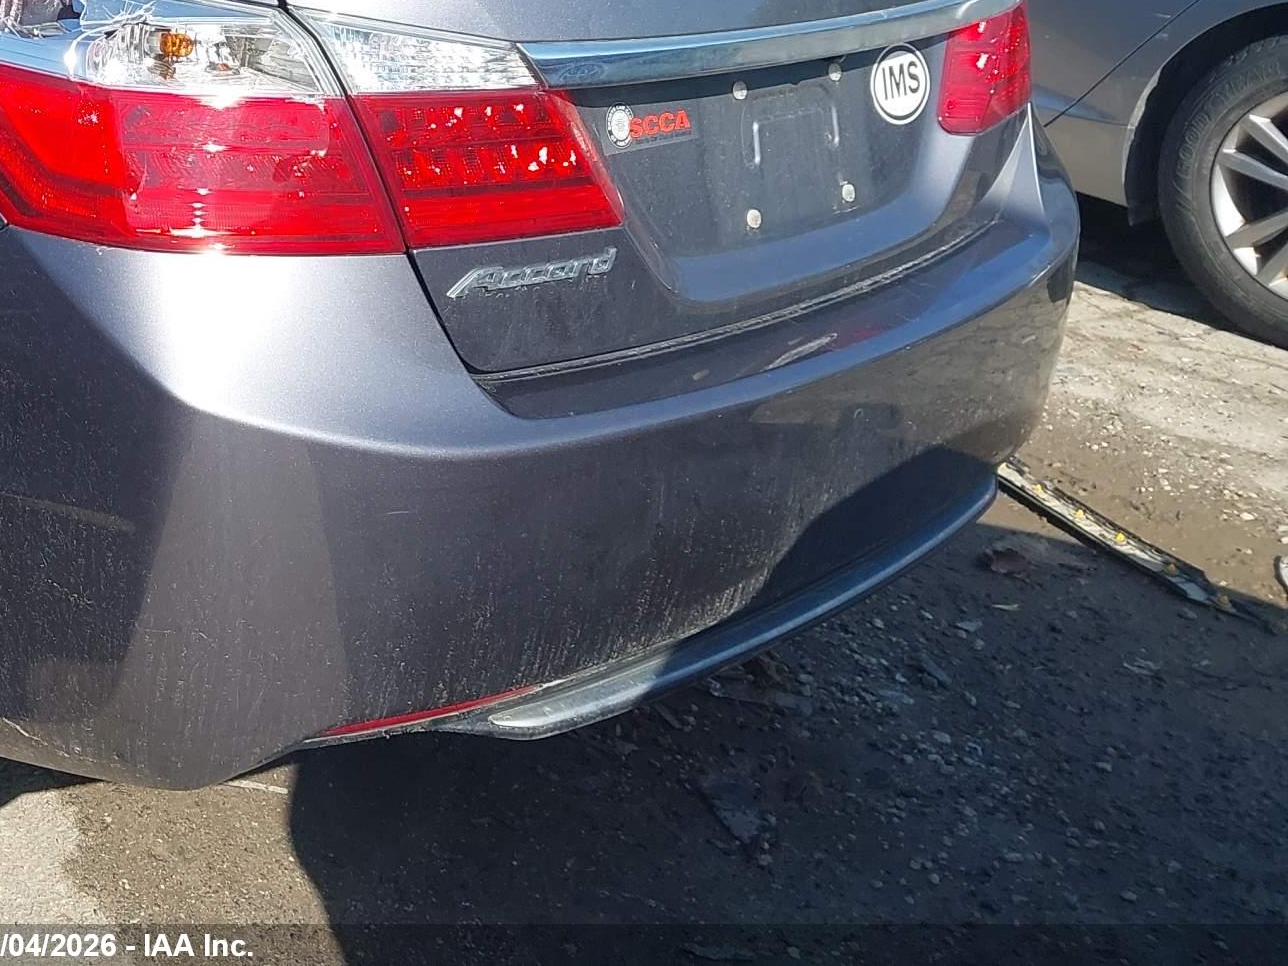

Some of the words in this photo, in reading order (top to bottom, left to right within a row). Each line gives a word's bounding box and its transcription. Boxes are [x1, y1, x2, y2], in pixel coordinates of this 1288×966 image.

[882, 60, 920, 101] IMS
[629, 109, 691, 138] SCCA
[446, 247, 617, 298] Accord
